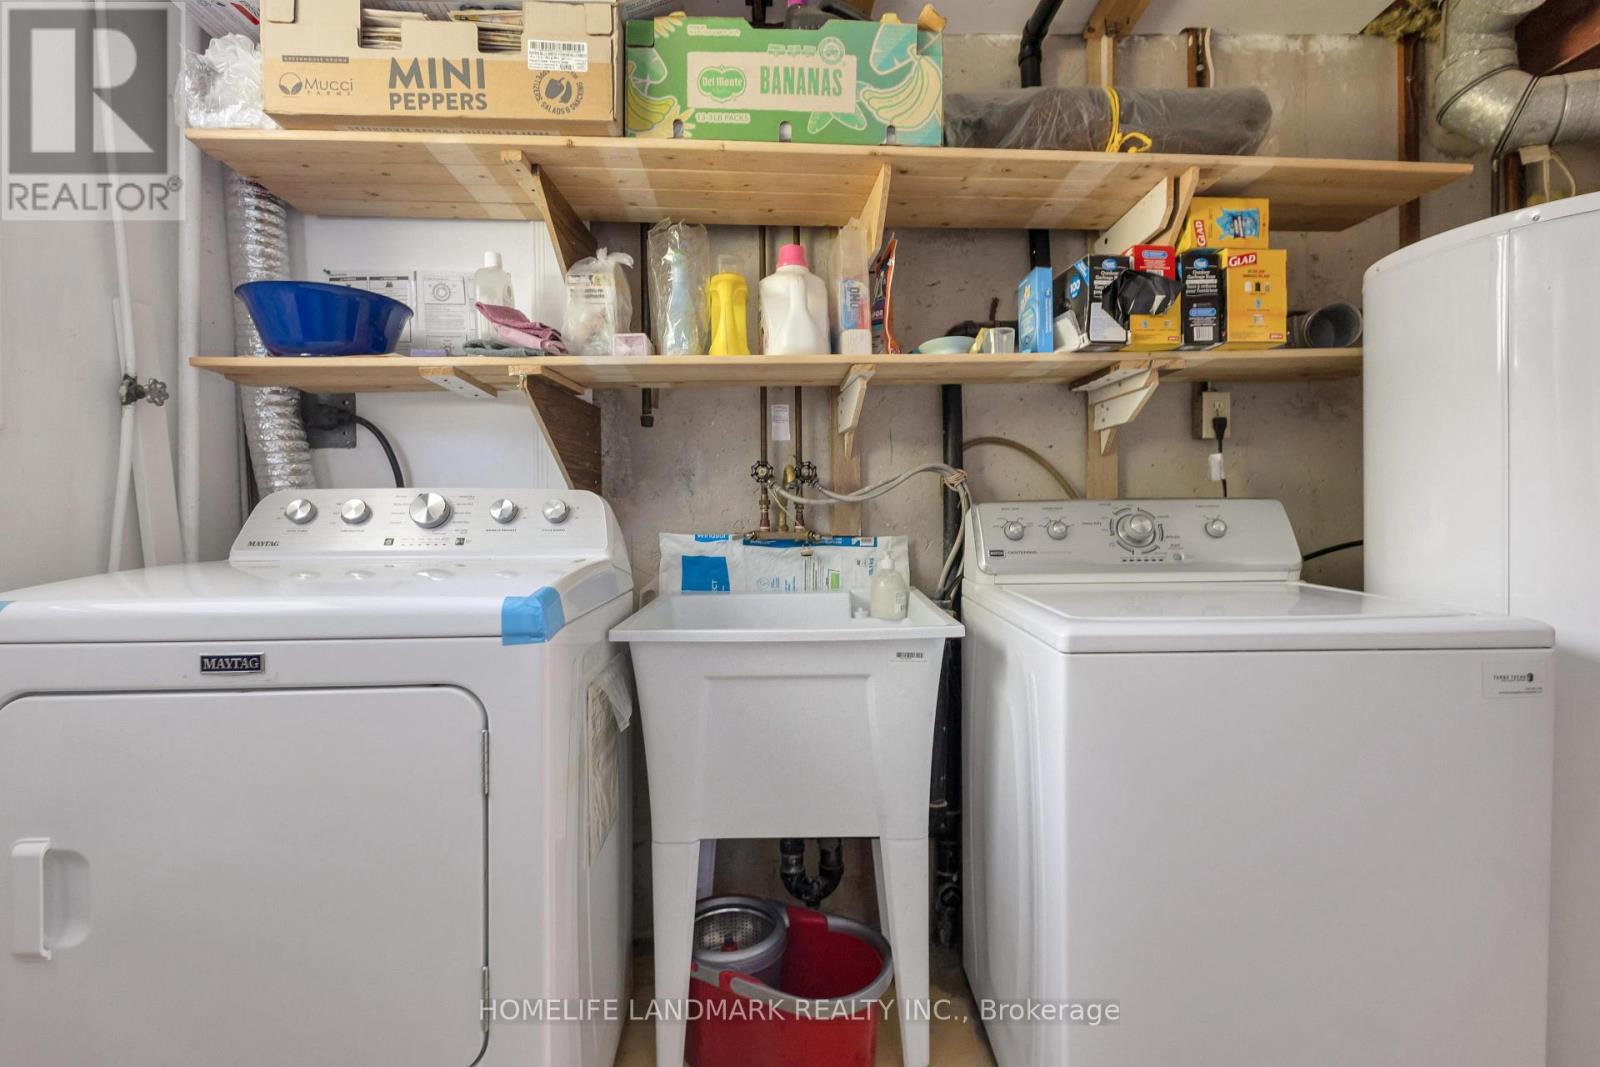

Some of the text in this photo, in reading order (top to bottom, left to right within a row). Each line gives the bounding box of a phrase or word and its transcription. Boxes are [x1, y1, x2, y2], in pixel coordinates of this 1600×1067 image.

[388, 57, 485, 89] MINI
[304, 77, 353, 91] Mucci
[703, 77, 743, 87] Del Monte
[760, 66, 842, 97] BANANAS
[389, 93, 488, 110] PEPPERS
[724, 114, 749, 122] PACKS
[1195, 221, 1206, 247] GLAD
[1229, 254, 1256, 267] GLAD
[1070, 280, 1080, 293] 100
[202, 657, 260, 670] MAYTAG
